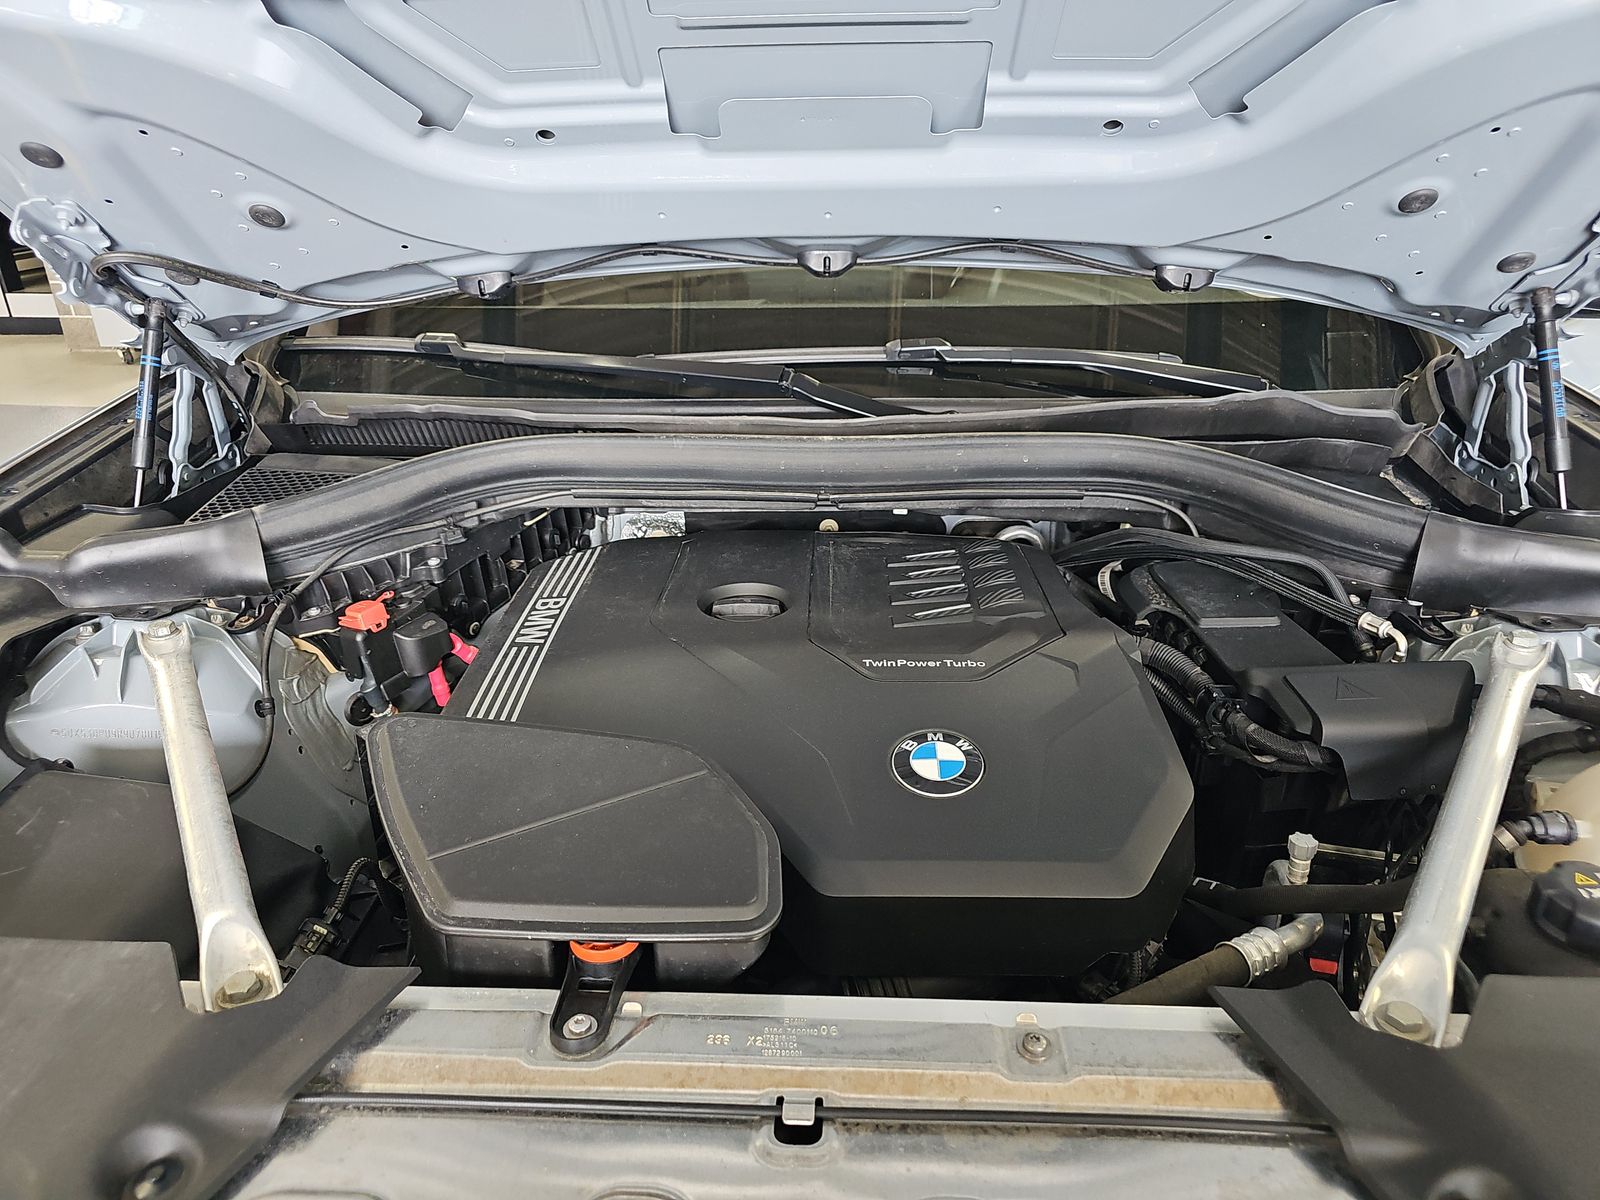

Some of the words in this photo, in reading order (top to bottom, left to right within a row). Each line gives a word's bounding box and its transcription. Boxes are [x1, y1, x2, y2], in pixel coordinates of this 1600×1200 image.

[515, 597, 567, 644] BMW
[862, 659, 941, 668] TwinPower
[942, 659, 986, 668] Turbo
[900, 732, 974, 751] BMW
